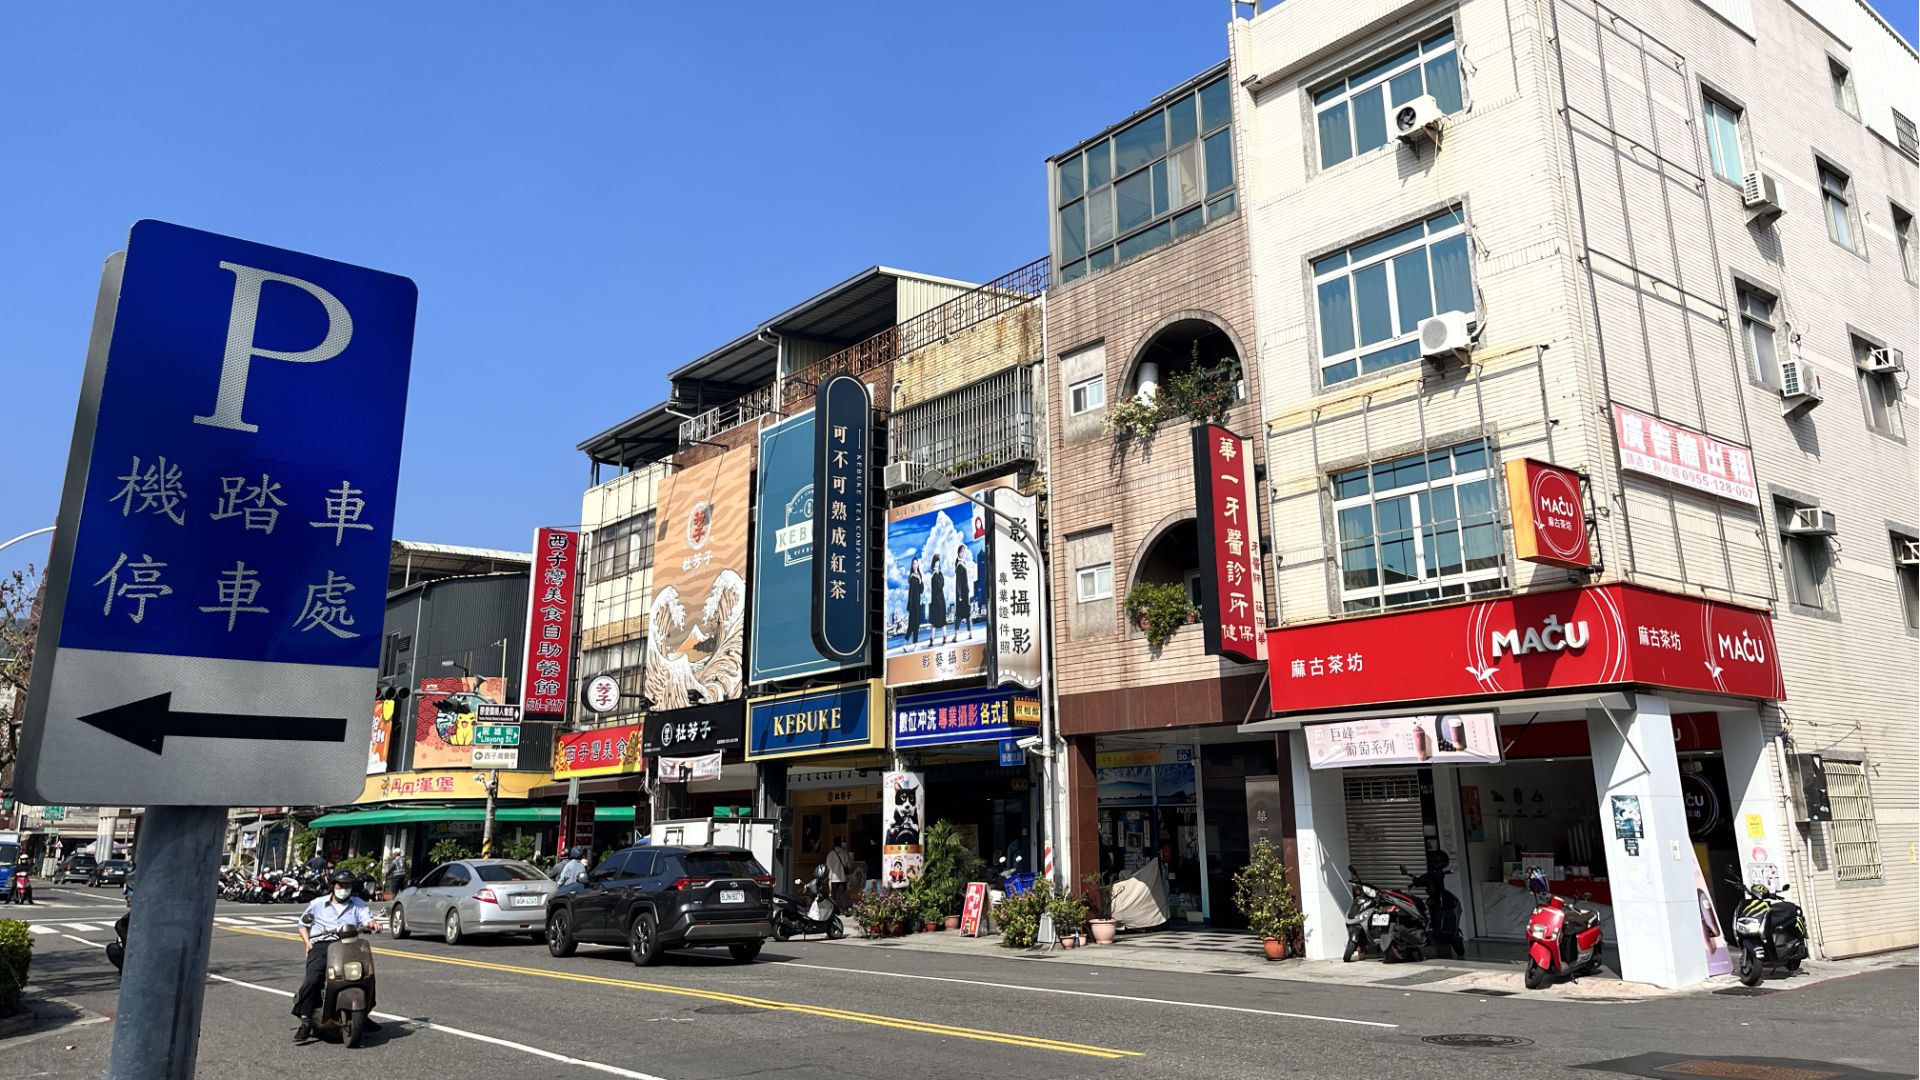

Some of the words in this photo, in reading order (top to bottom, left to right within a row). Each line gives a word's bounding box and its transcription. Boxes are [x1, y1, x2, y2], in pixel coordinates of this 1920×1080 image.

[193, 260, 353, 433] P
[1621, 411, 1751, 482] 廣告牆出租
[109, 455, 374, 547] 機踏車
[830, 425, 848, 600] 可不可熟成紅茶
[1219, 436, 1249, 619] 華一牙醫診所
[1547, 516, 1572, 531] 麻古茶坊
[1251, 541, 1261, 585] 牙醫師
[93, 552, 361, 640] 停車處
[1009, 517, 1031, 655] 影藝攝影
[534, 533, 569, 696] 西子灣美食自助餐館
[998, 572, 1011, 654] 專業證件照
[1221, 624, 1255, 642] 健保
[1637, 624, 1682, 651] 麻古茶坊
[1291, 652, 1363, 678] 麻古茶坊
[773, 707, 841, 737] KEBUKE
[938, 703, 978, 729] 專業攝影
[481, 736, 505, 744] Lisyong
[675, 720, 711, 743] 杜芳子
[1330, 725, 1354, 742] 巨峰
[565, 737, 628, 763] 西子灣美食
[1345, 740, 1396, 757] 葡萄系列
[391, 777, 454, 796] 丹丹漢堡
